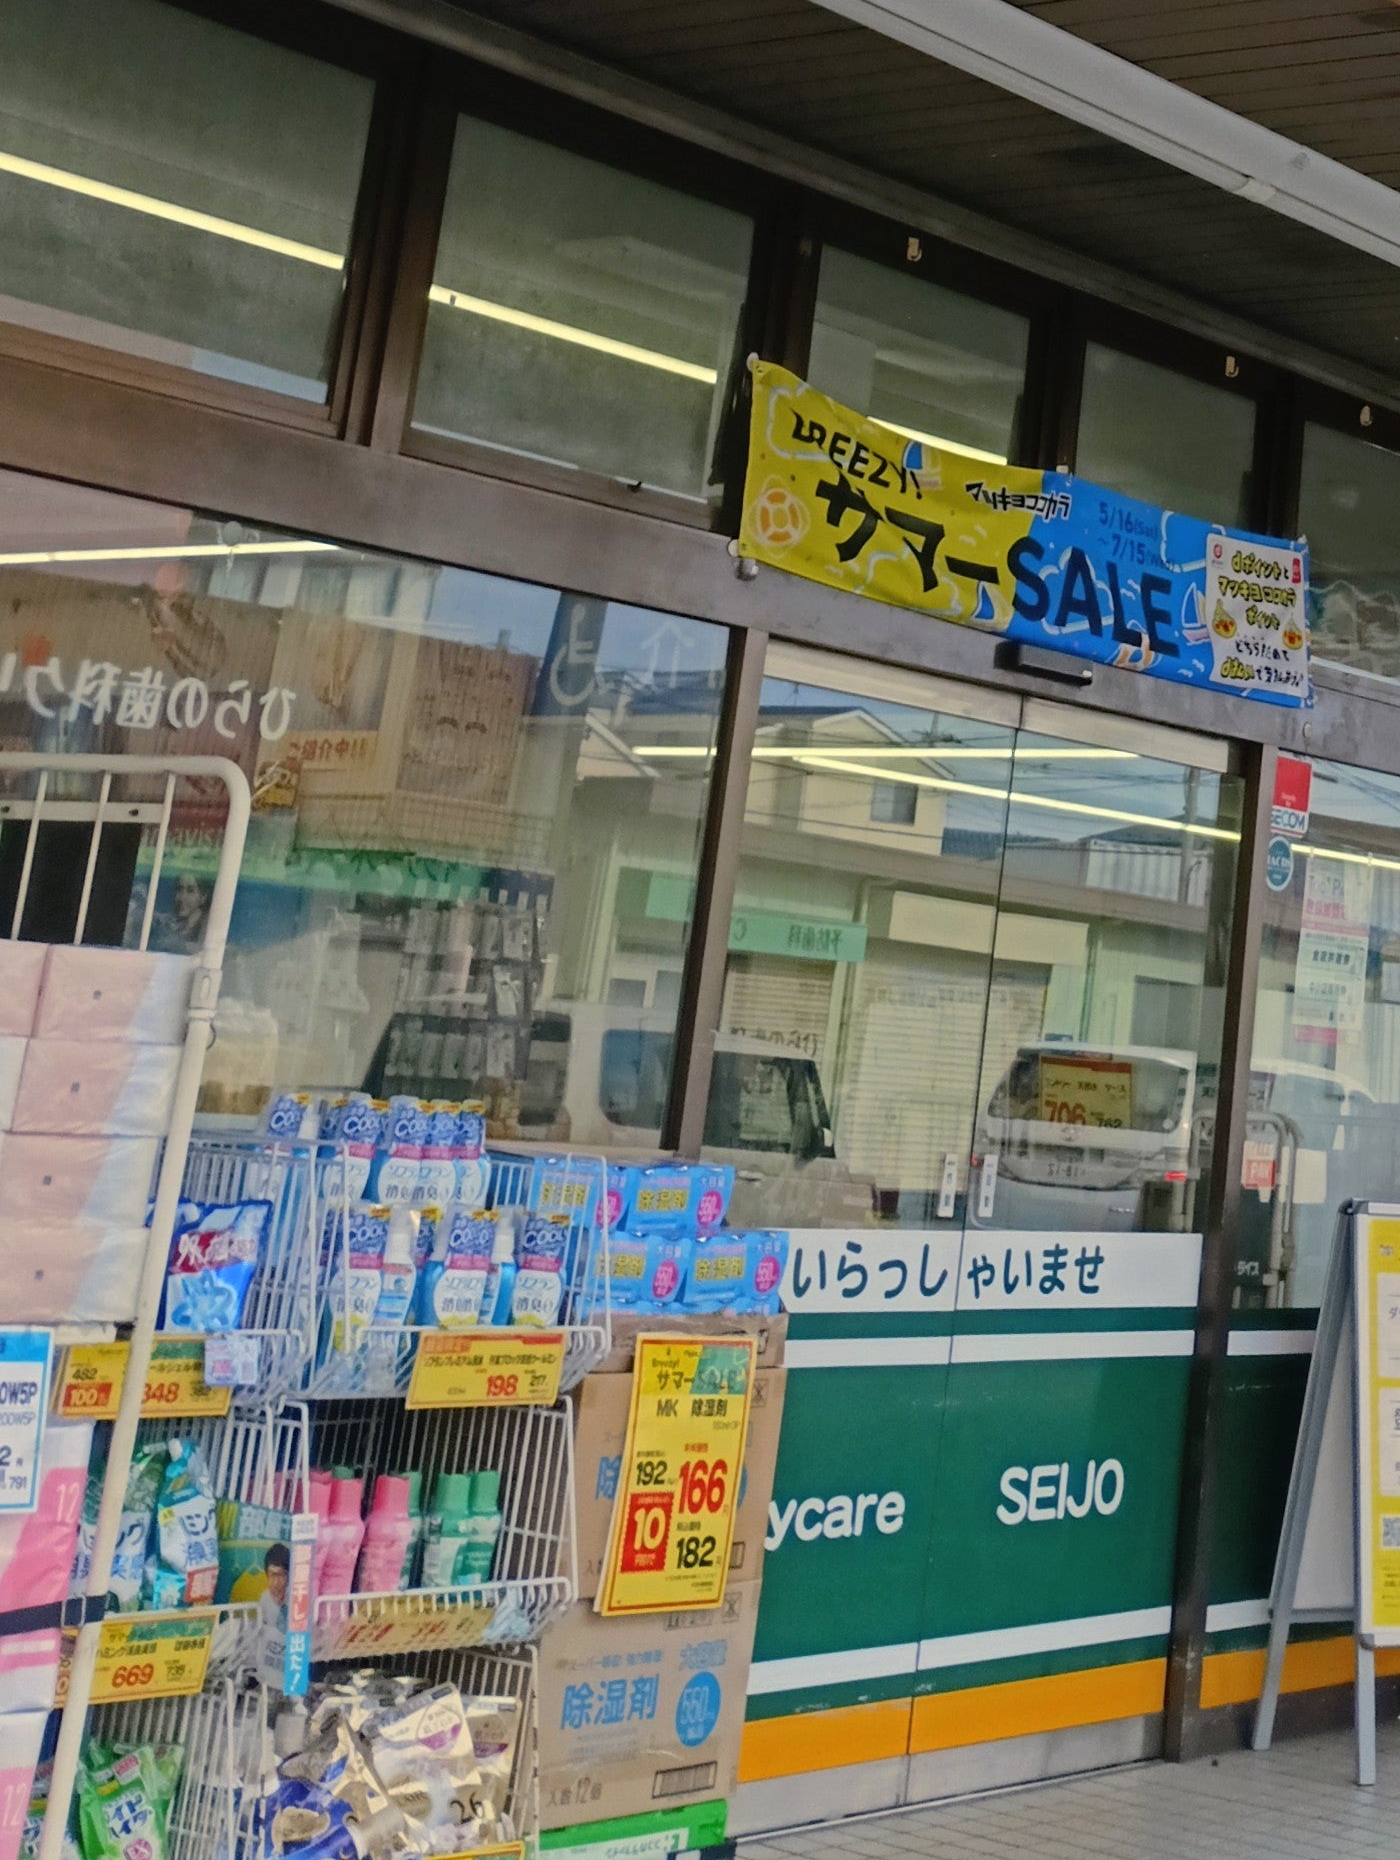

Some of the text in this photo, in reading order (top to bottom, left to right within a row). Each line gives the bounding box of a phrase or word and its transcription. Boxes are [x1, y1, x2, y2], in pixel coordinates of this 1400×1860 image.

[792, 1240, 1106, 1300] いらっしゃいませ
[69, 1388, 97, 1407] 100
[486, 1373, 519, 1396] 198
[656, 1398, 728, 1418] MK 除湿剤
[636, 1460, 668, 1487] 192
[678, 1458, 729, 1515] 166
[995, 1457, 1125, 1526] SEIJO
[633, 1506, 667, 1551] 10
[675, 1535, 717, 1569] 182
[112, 1663, 155, 1689] 669
[560, 1673, 660, 1730] 除湿剤
